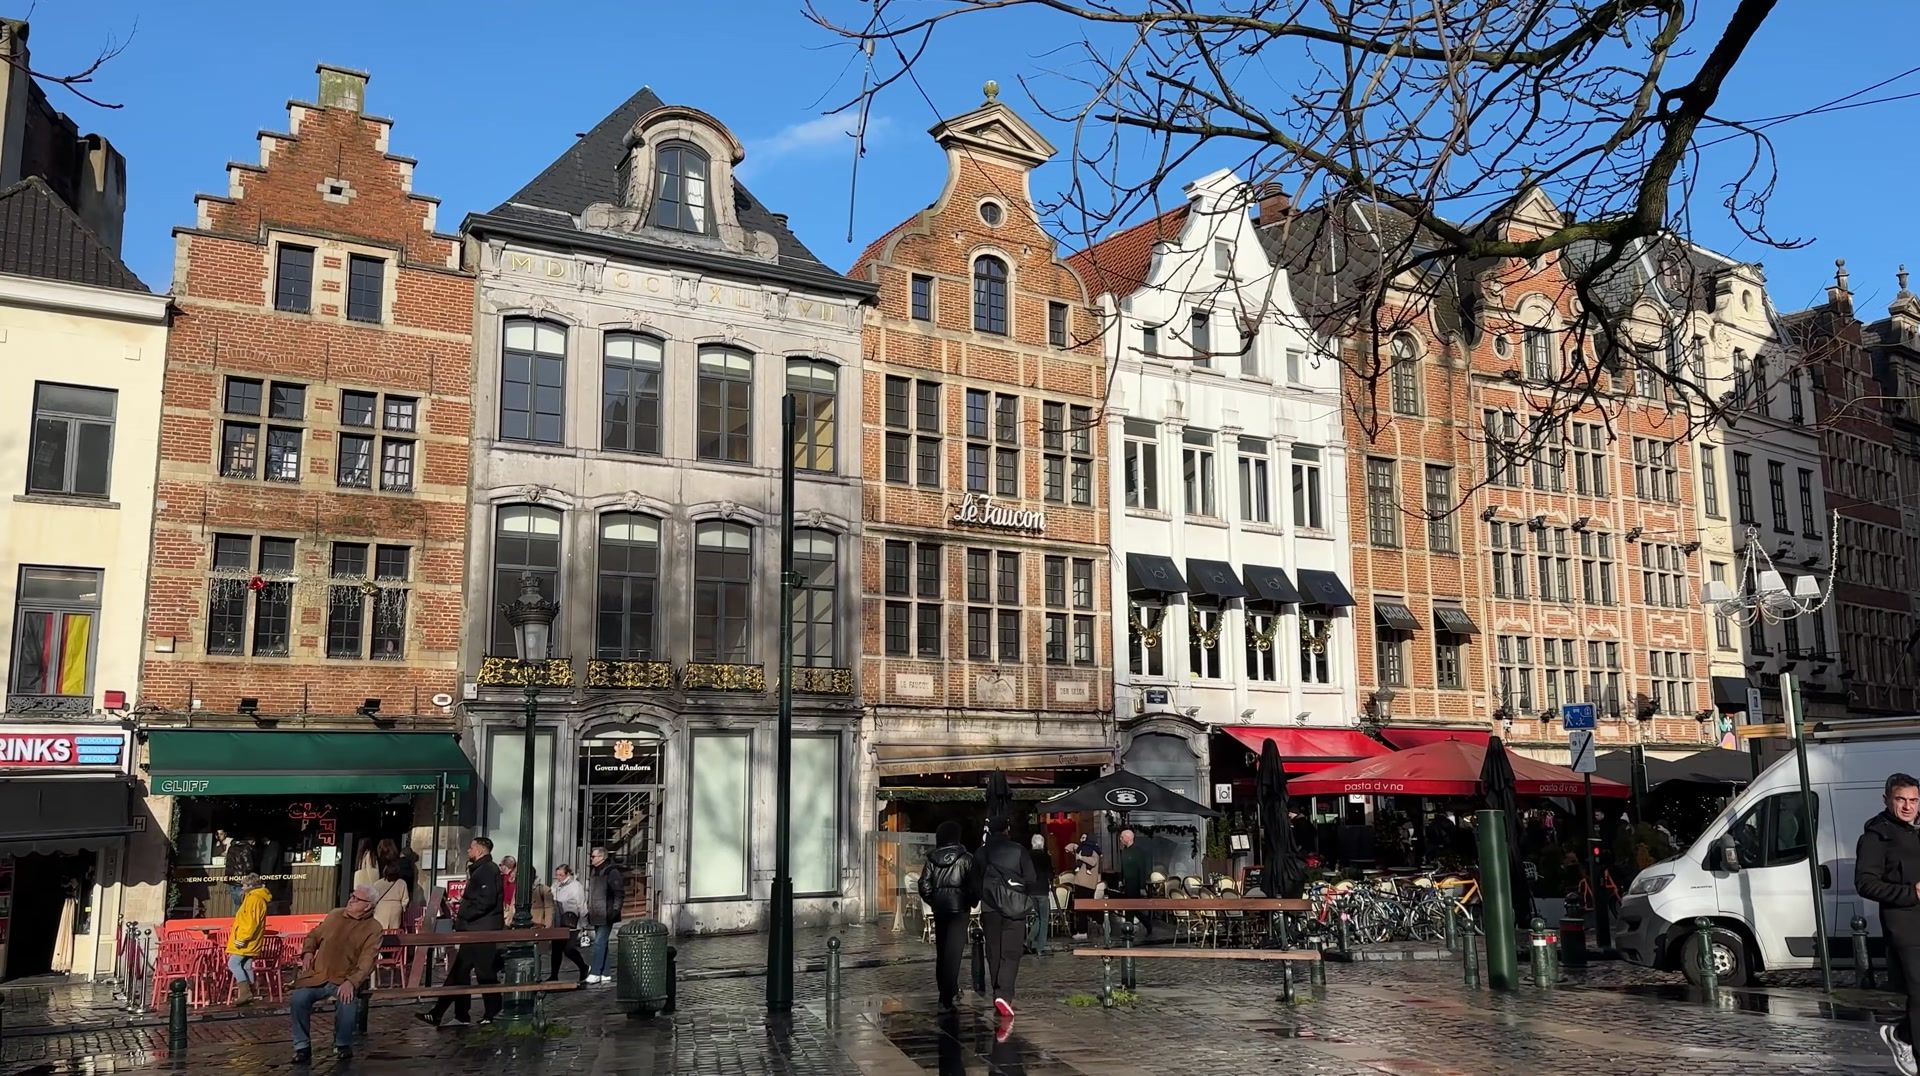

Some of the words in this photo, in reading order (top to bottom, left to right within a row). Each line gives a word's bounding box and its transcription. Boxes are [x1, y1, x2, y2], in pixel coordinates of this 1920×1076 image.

[953, 492, 978, 522] Le
[978, 493, 1046, 528] Faucon
[161, 780, 209, 792] CLIFF
[1344, 782, 1371, 792] pasta
[1117, 793, 1137, 804] 8
